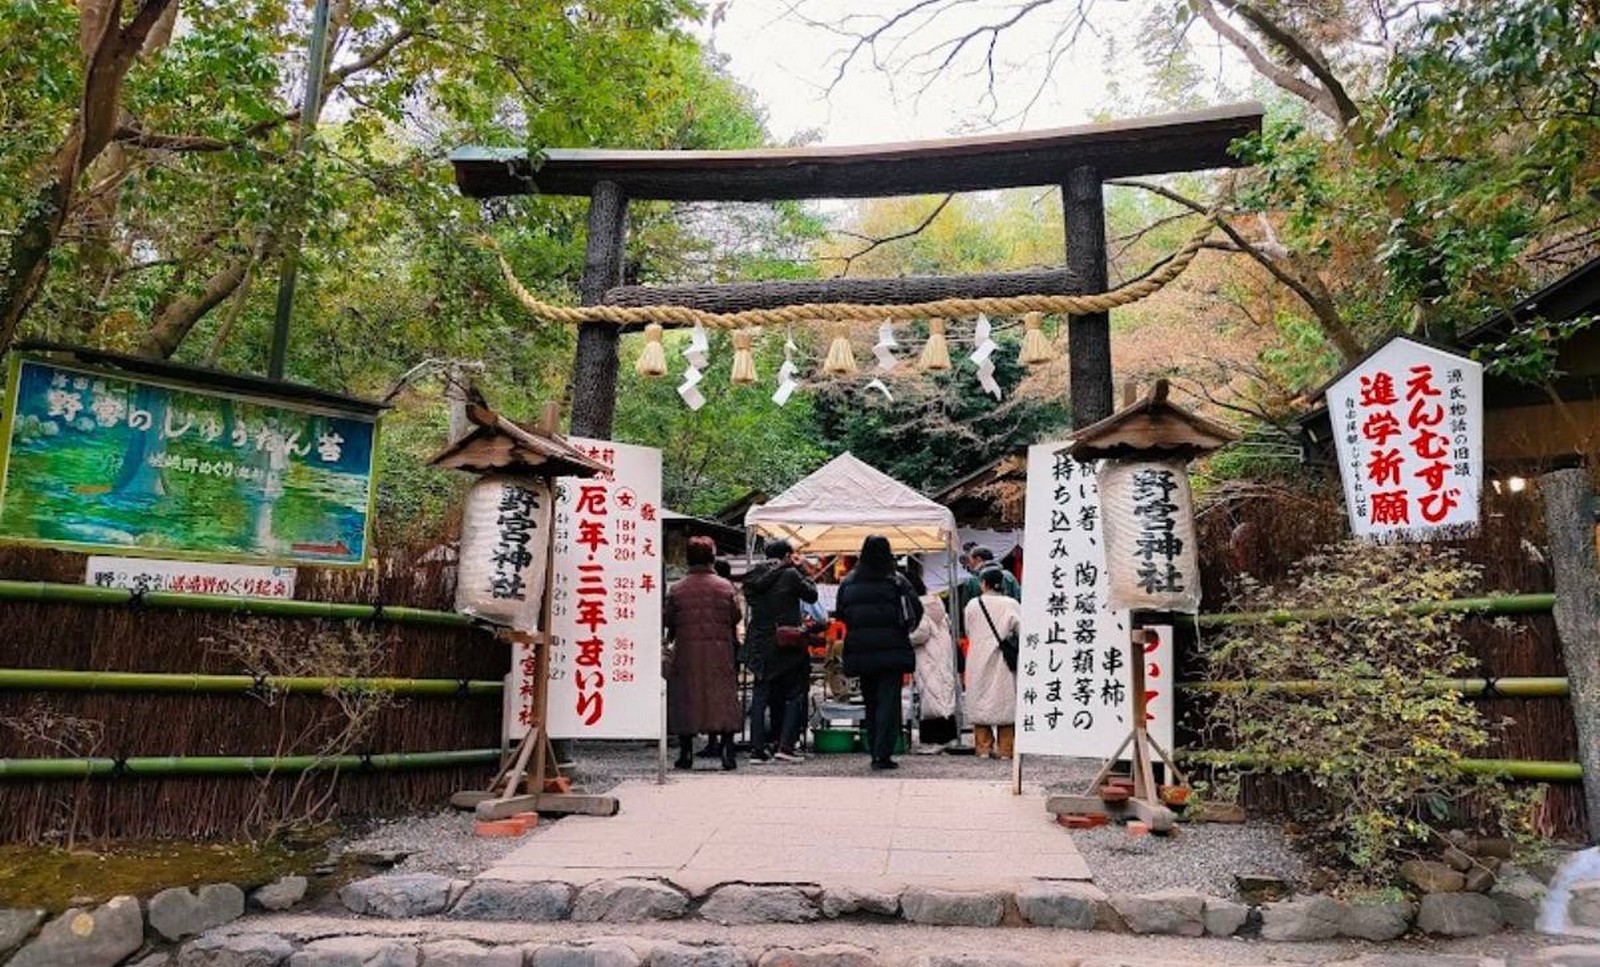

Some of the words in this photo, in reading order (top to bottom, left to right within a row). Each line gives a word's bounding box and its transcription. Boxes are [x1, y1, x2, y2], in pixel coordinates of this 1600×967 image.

[1358, 371, 1411, 526] 進学祈願
[1405, 365, 1462, 523] えんむすび
[488, 485, 540, 600] 野宮神社
[1044, 453, 1074, 731] 持ち込みを禁止します
[1132, 469, 1184, 595] 野宮神社
[1023, 633, 1040, 733] 野宮神社
